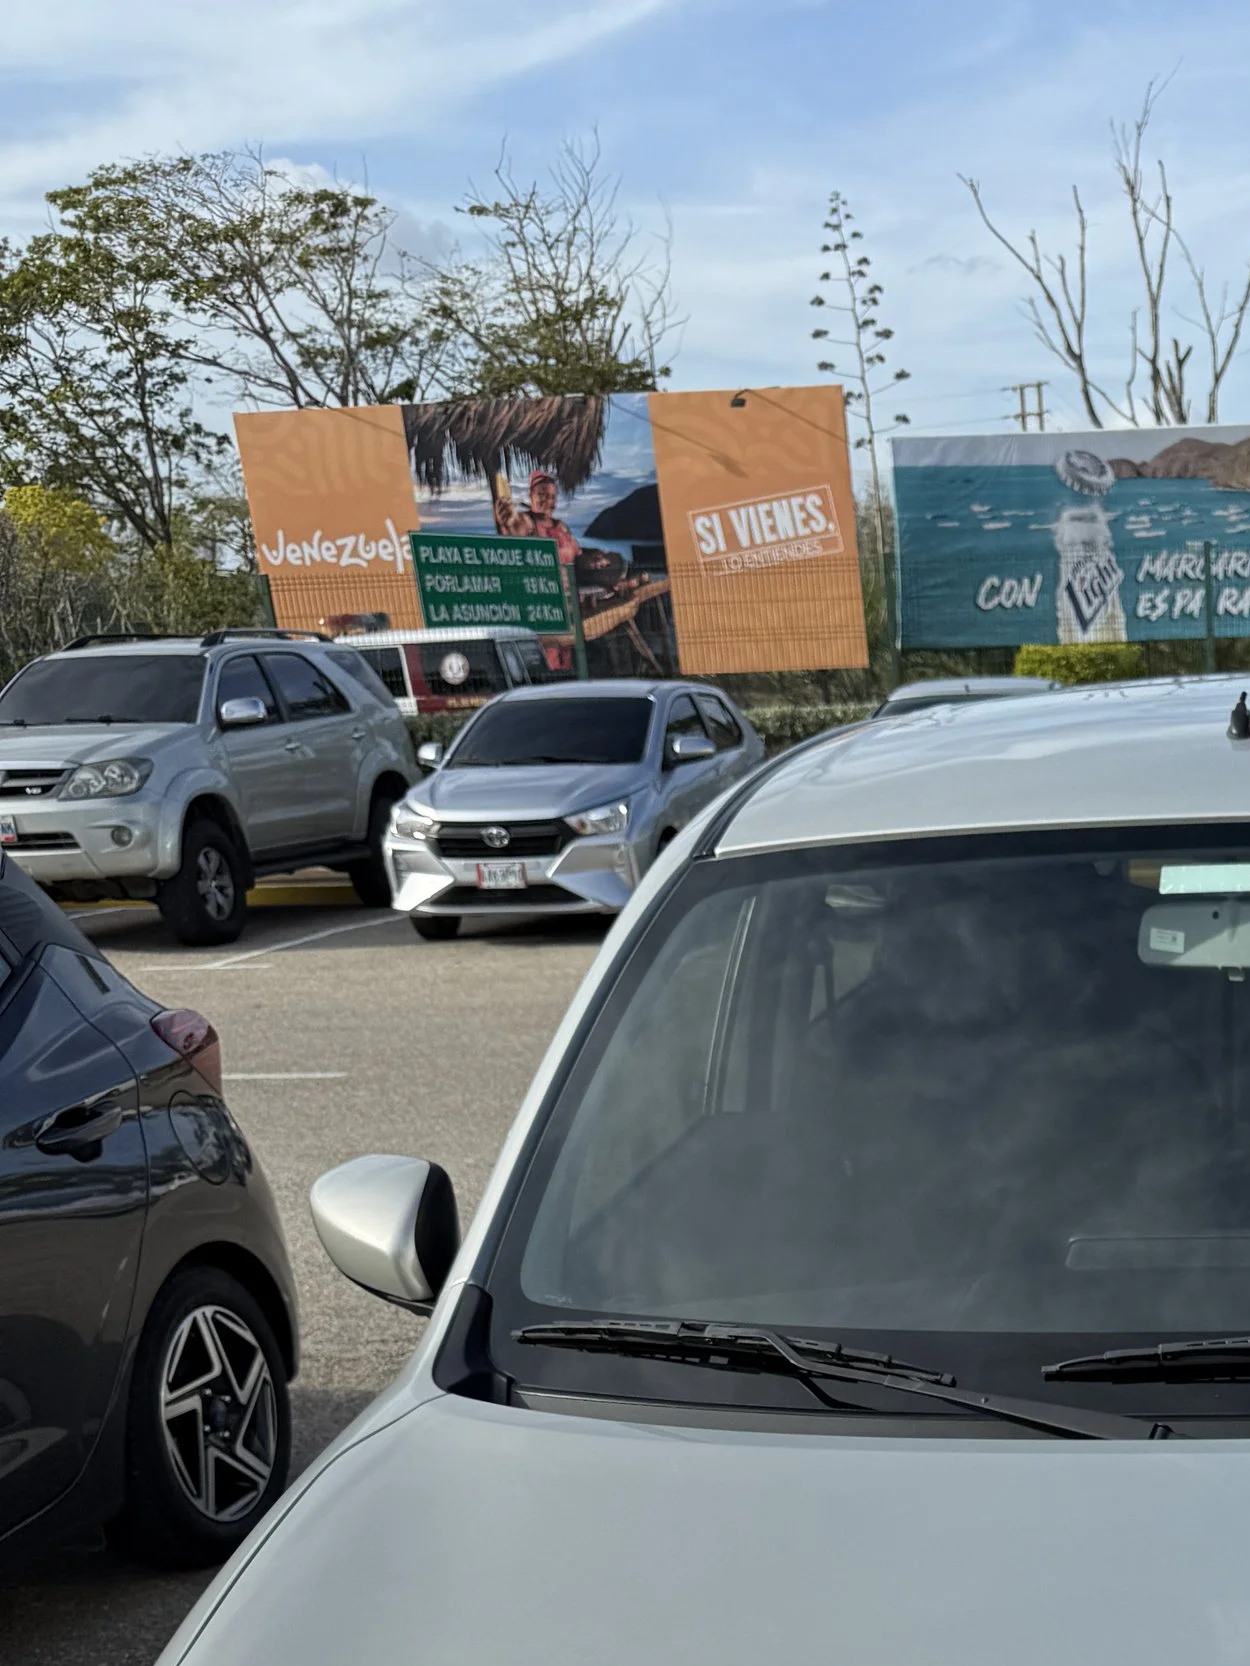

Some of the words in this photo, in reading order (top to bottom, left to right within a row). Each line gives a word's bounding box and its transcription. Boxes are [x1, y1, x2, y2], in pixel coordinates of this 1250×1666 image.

[695, 512, 727, 554] SI
[419, 546, 462, 564] PLAYA
[463, 547, 482, 565] EL
[481, 548, 524, 566] YAQUE
[425, 575, 502, 593] PORLAMAR
[976, 572, 1043, 610] CON
[429, 604, 450, 621] LA
[452, 602, 521, 622] ASUNCIÓN
[1136, 588, 1170, 621] ES
